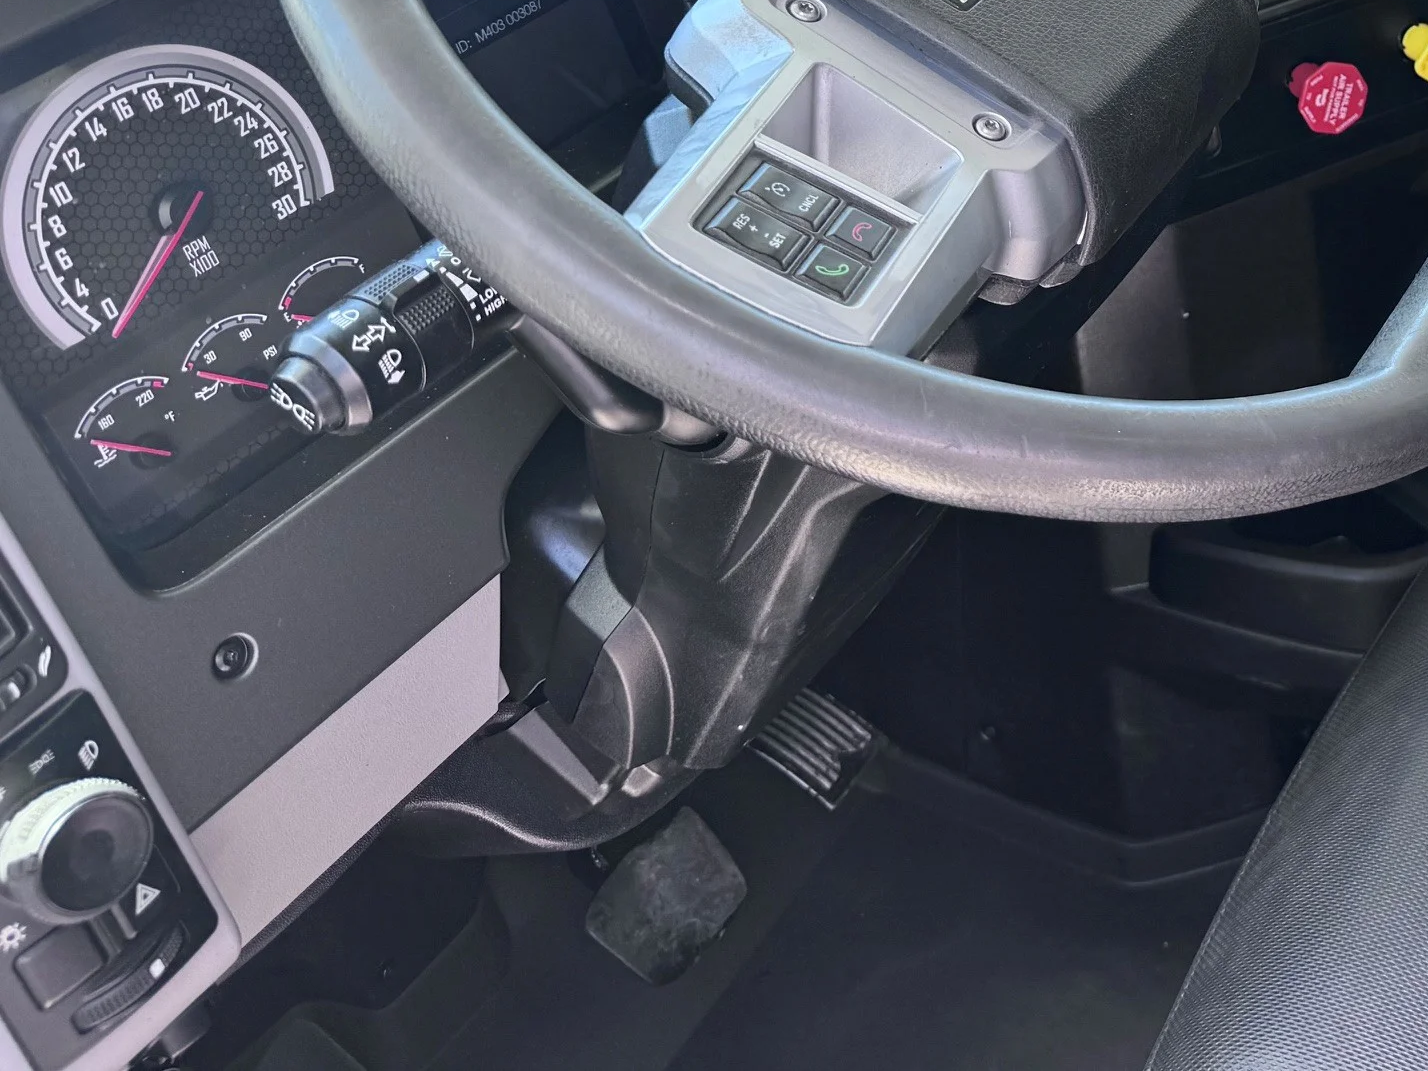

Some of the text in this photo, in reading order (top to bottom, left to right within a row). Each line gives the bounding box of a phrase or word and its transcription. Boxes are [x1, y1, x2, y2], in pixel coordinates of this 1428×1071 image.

[455, 39, 473, 55] ID:
[474, 19, 506, 44] M403
[111, 97, 134, 123] 16
[142, 87, 164, 112] 18
[175, 87, 200, 115] 20
[207, 97, 233, 124] 22
[1329, 73, 1347, 126] AIR SUPPLY
[1338, 83, 1354, 119] TRAILER
[84, 117, 107, 142] 14
[234, 115, 258, 137] 24
[254, 132, 279, 159] 26
[62, 147, 86, 173] 12
[267, 162, 293, 188] 28
[49, 181, 73, 208] 10
[272, 194, 297, 220] 30
[798, 194, 819, 213] CNCL
[48, 216, 67, 239] 8
[732, 213, 751, 230] RES
[182, 235, 211, 261] RPM
[769, 232, 787, 249] SET
[55, 248, 74, 270] 6
[189, 250, 220, 277] X100
[74, 277, 90, 299] 4
[479, 286, 498, 305] LO
[101, 298, 119, 321] 0
[283, 312, 292, 323] E
[239, 328, 252, 342] 90
[203, 350, 217, 365] 30
[263, 344, 278, 360] PSI
[135, 389, 155, 407] 220
